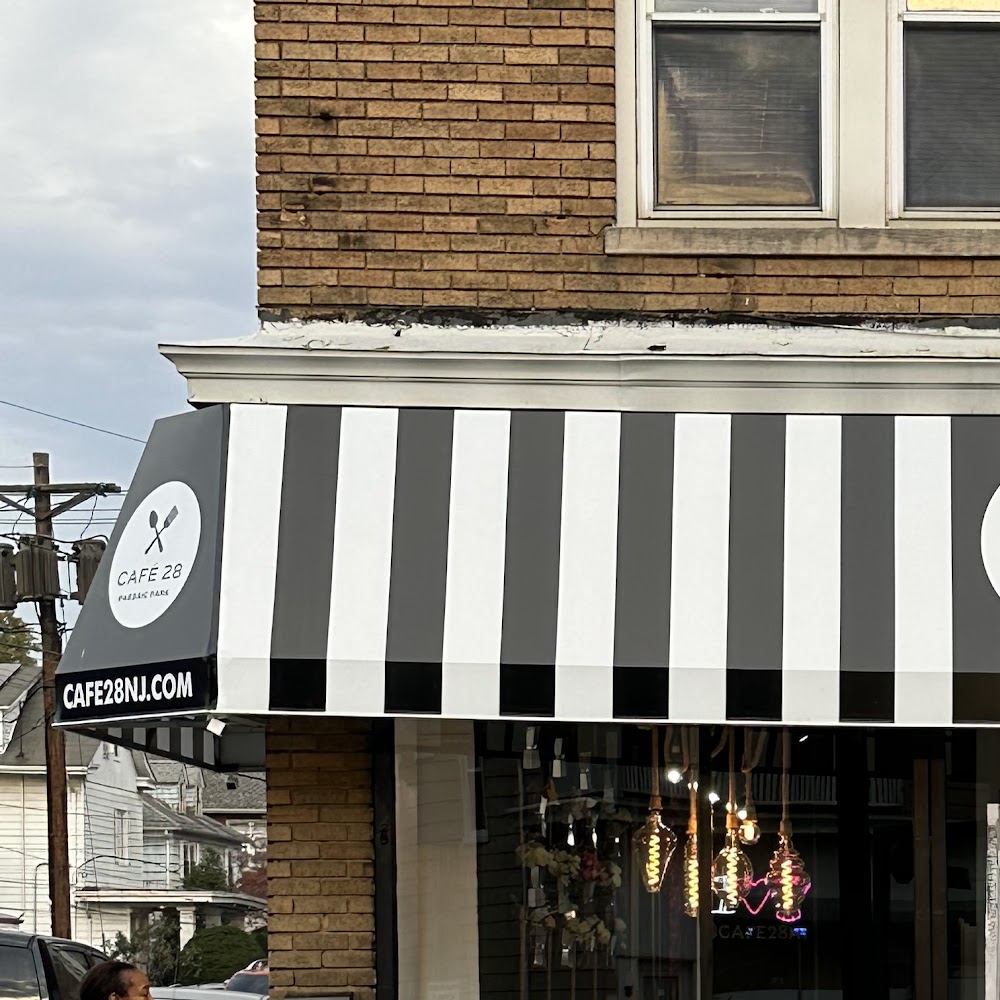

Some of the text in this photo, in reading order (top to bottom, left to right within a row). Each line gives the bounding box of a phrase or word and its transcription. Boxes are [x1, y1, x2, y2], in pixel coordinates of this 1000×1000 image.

[117, 562, 183, 587] CAFÉ 28
[63, 671, 193, 709] CAFE28NJ.COM
